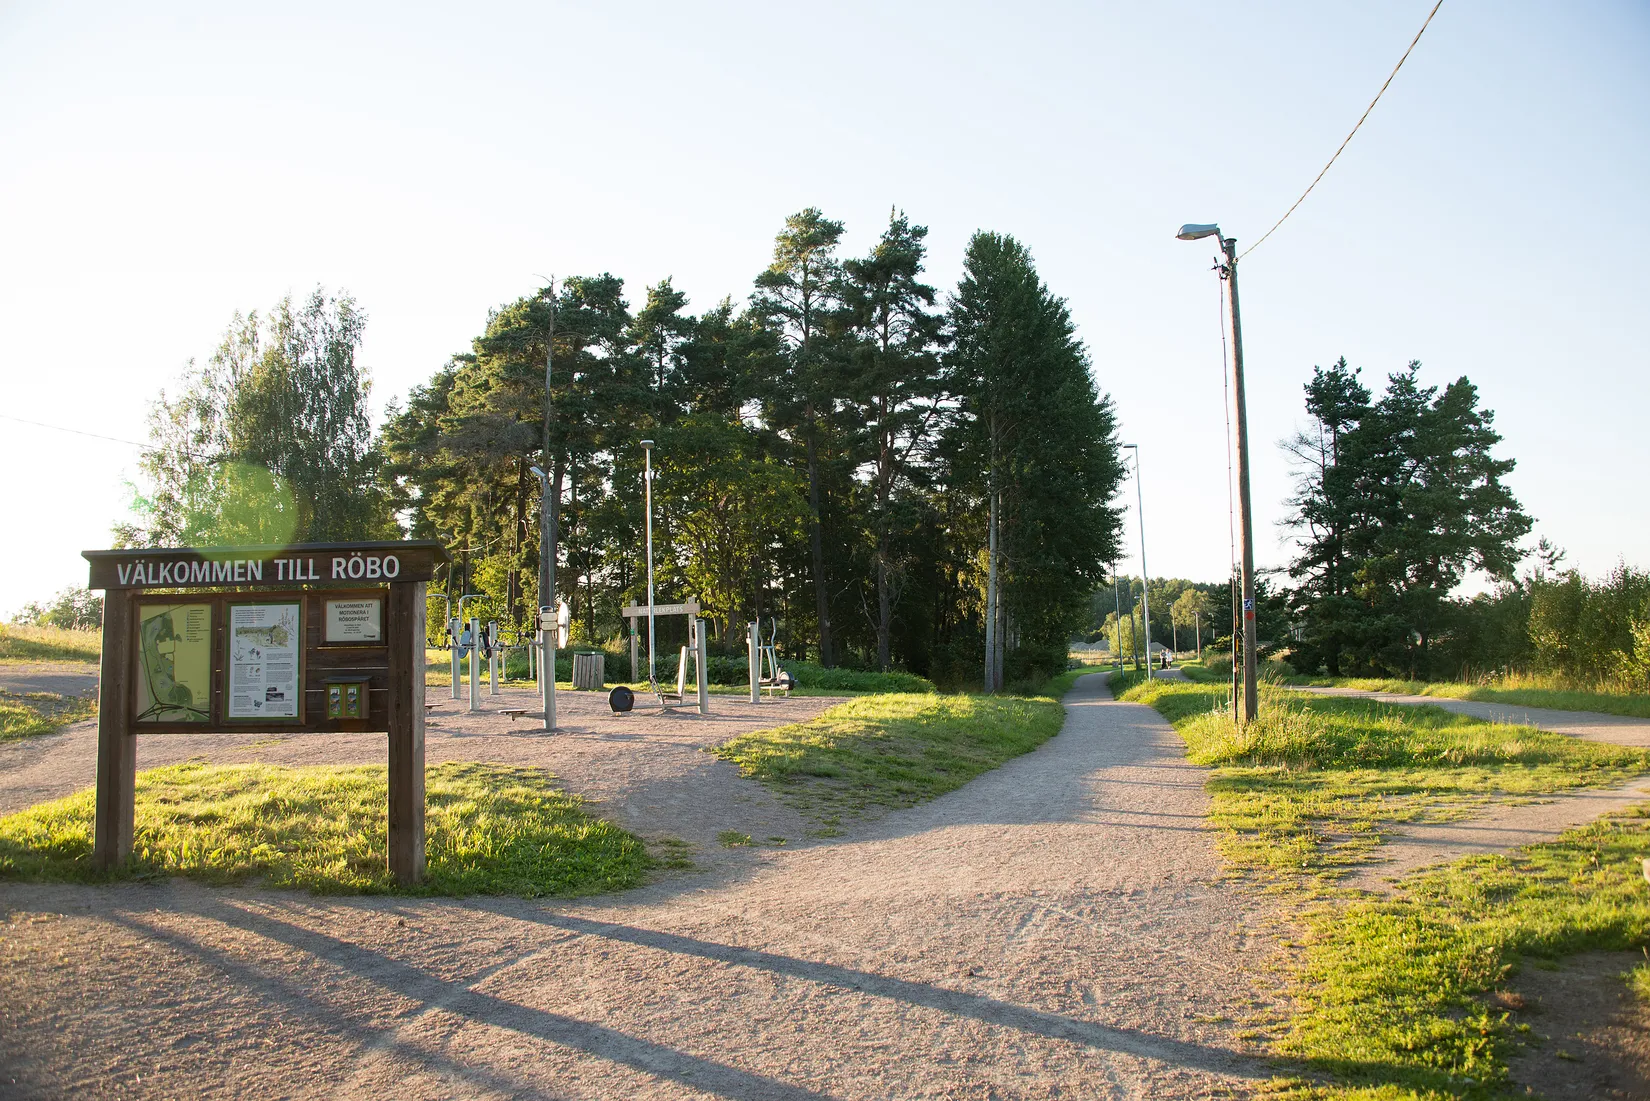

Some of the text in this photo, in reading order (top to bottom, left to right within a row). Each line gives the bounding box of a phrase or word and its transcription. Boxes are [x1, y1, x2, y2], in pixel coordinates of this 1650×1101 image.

[117, 552, 400, 585] VÄLKOMMEN TILL RÖBO
[638, 606, 683, 614] NATRLEKPLATS
